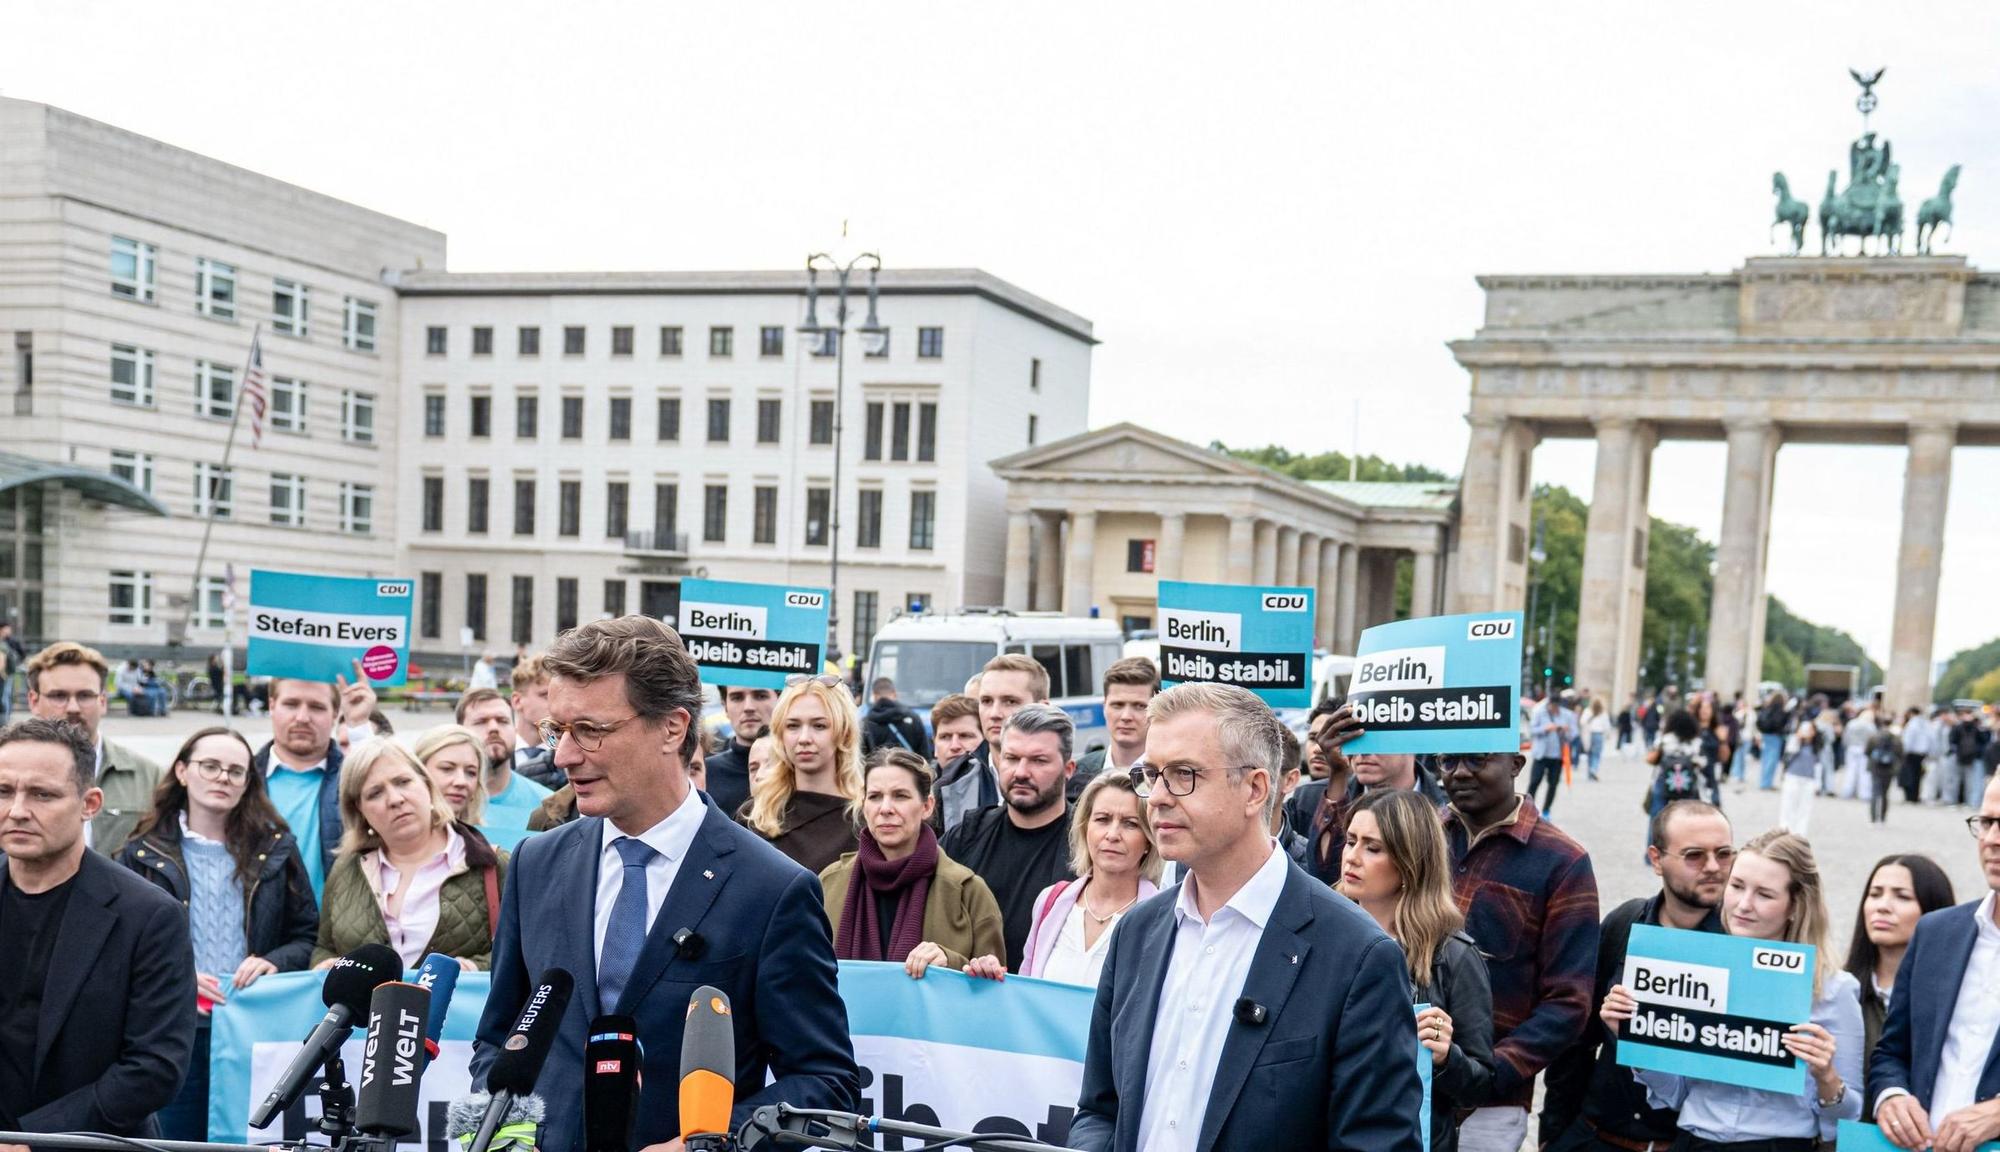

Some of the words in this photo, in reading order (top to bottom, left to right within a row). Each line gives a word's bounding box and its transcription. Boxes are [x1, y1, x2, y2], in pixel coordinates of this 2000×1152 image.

[379, 585, 407, 595] CDU
[788, 594, 821, 606] CDU
[1265, 597, 1304, 609] CDU
[256, 614, 331, 638] Stefan
[337, 622, 398, 641] Evers
[690, 609, 757, 636] Berlin,
[1167, 617, 1231, 648] Berlin,
[1471, 622, 1511, 637] CDU
[688, 640, 742, 663] bleib
[745, 646, 812, 669] stabil.
[1167, 652, 1215, 680] bleib
[1218, 659, 1296, 682] stabil.
[1358, 656, 1433, 685] Berlin,
[1352, 695, 1415, 723] bleib
[1419, 693, 1502, 721] stabil.
[334, 956, 355, 970] dpa
[1756, 952, 1801, 969] CDU
[1633, 966, 1715, 1008] Berlin,
[516, 984, 552, 1032] REUTERS
[1629, 1009, 1696, 1043] bleib
[1700, 1022, 1787, 1058] stabil.
[599, 1062, 618, 1071] ntv
